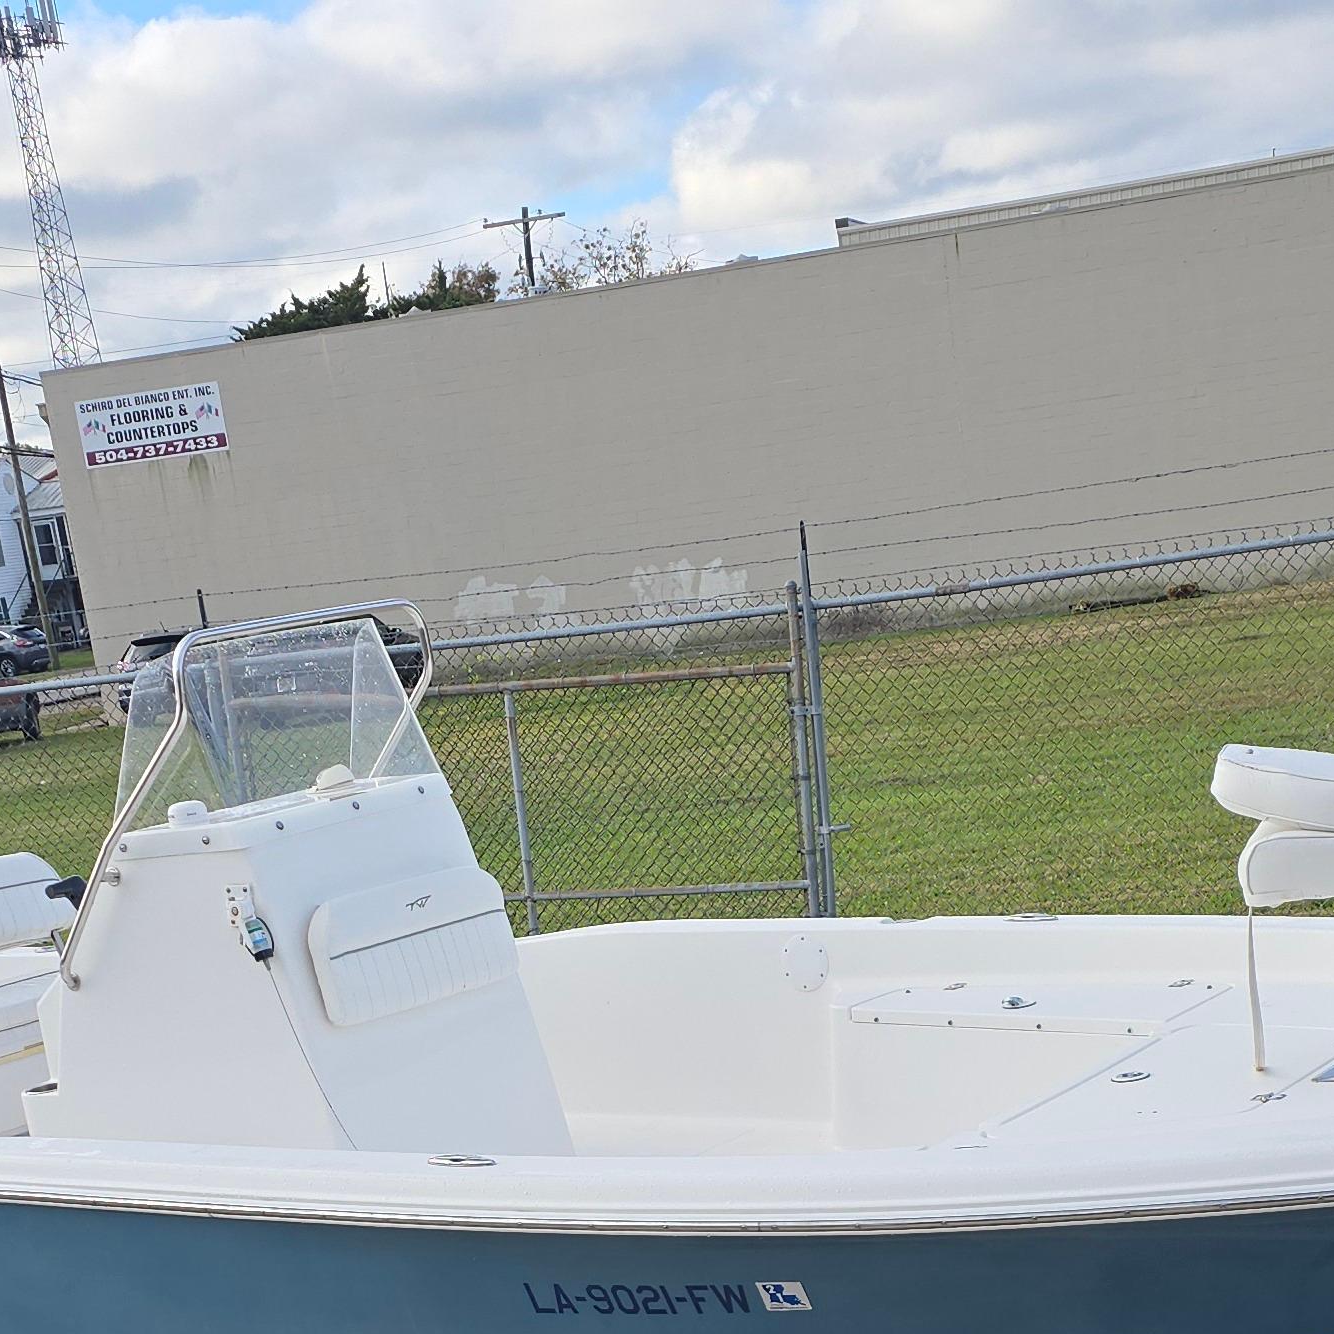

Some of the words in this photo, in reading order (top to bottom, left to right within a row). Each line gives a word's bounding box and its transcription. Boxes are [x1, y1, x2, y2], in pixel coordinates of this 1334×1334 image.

[80, 402, 114, 414] SCHIRO
[116, 397, 132, 409] DEL
[135, 391, 169, 406] BIANCO
[172, 388, 193, 400] ENT.
[194, 385, 215, 398] INC.
[110, 406, 174, 426] FLOORING
[178, 404, 188, 416] &
[107, 420, 198, 445] COUNTERTOPS
[95, 435, 218, 463] 504-737-7433
[523, 1283, 751, 1315] LA-9021-FW
